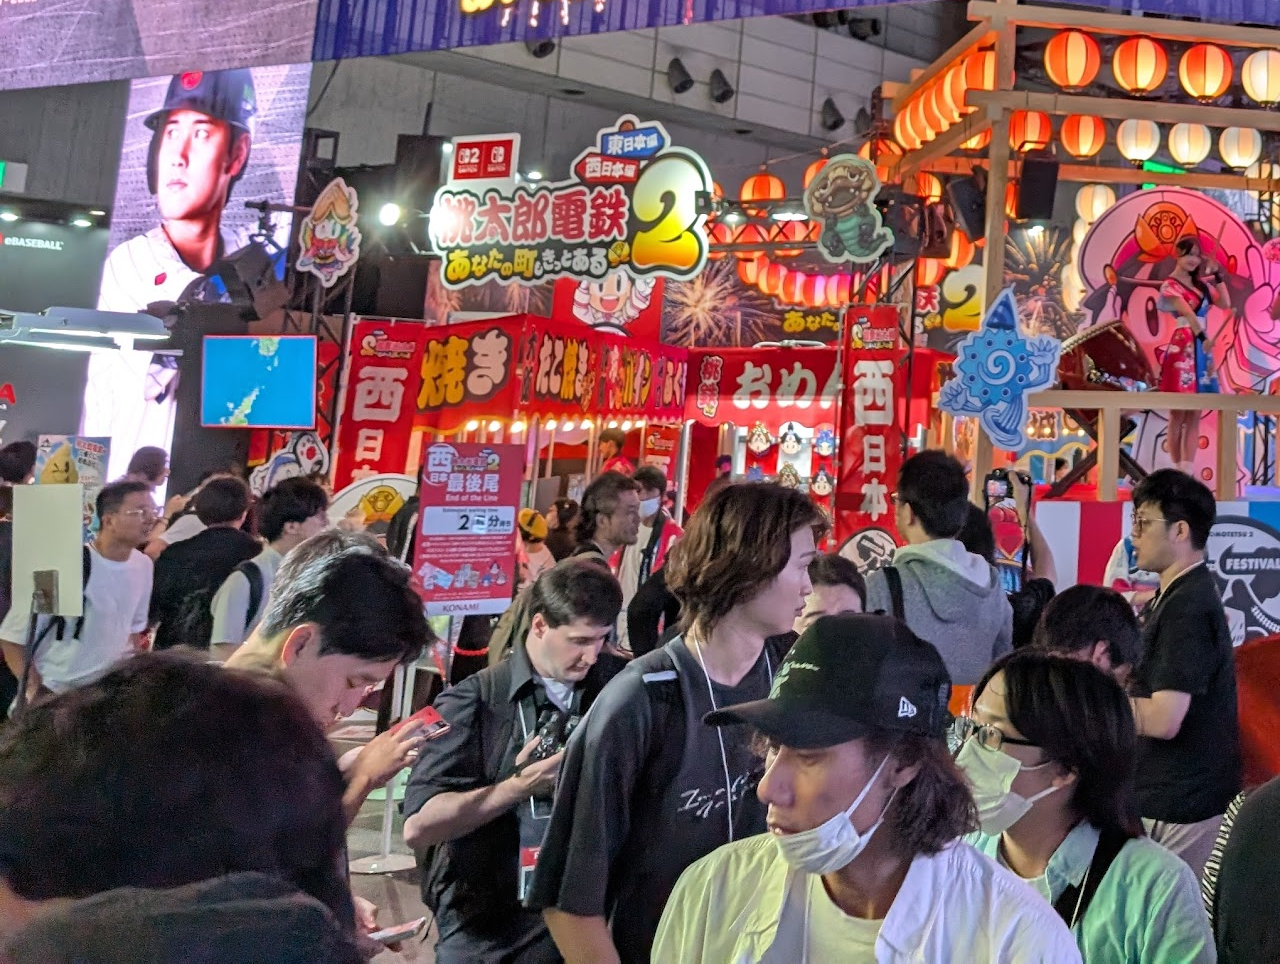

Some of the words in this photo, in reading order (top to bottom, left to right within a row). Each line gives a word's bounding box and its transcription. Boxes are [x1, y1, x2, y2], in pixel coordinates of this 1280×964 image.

[440, 186, 627, 246] 桃太郎電鉄
[632, 155, 706, 270] 2
[416, 328, 509, 410] 焼き
[851, 359, 894, 522] 西日本
[427, 444, 453, 473] 西
[446, 473, 499, 493] 最後尾
[445, 494, 460, 502] End
[461, 494, 469, 502] of
[470, 494, 482, 502] the
[483, 494, 498, 502] Line
[457, 514, 470, 531] 2
[442, 603, 480, 612] KONAMI
